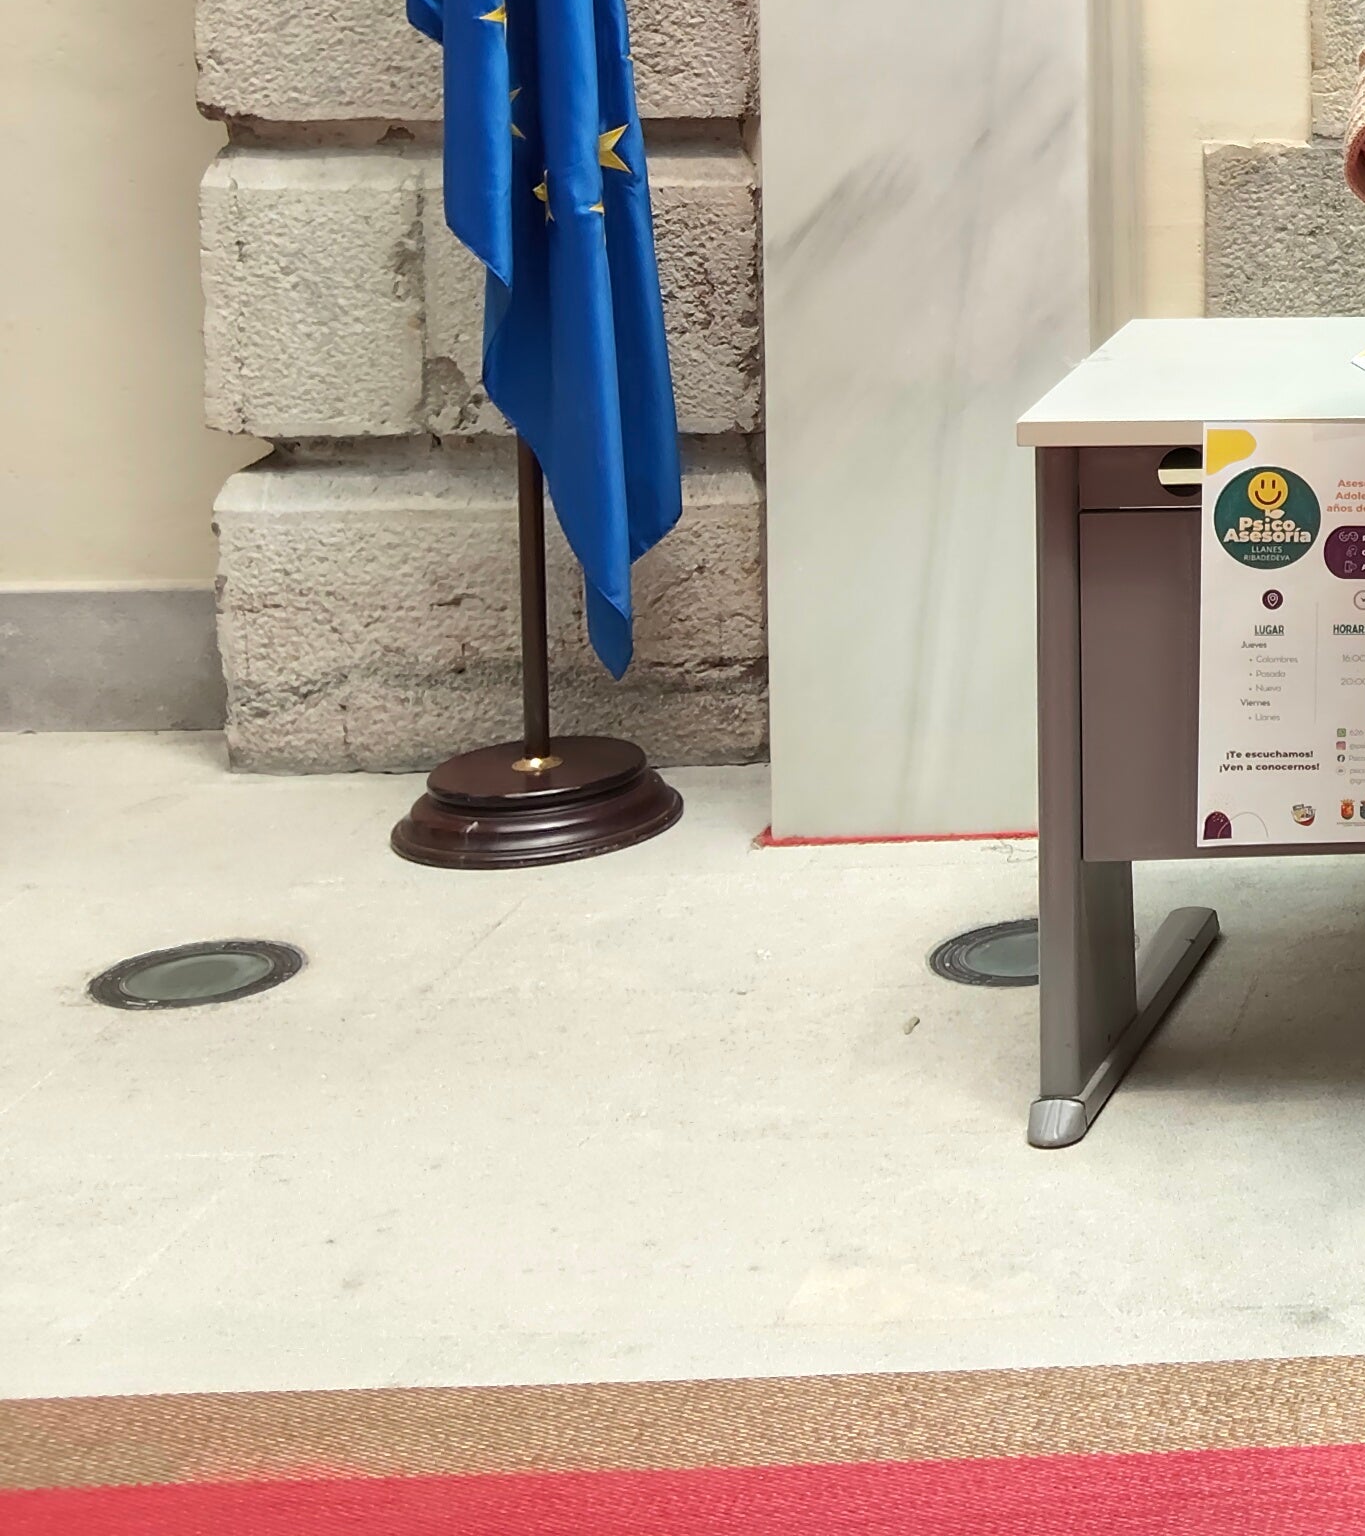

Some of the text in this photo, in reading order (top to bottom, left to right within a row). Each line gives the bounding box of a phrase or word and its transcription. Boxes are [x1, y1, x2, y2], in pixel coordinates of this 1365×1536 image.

[1326, 504, 1352, 512] años
[1238, 516, 1296, 531] Psico
[1222, 526, 1311, 543] Asesoría
[1251, 545, 1283, 553] LLANES
[1243, 553, 1290, 561] RIBADEDEVA
[1254, 625, 1284, 634] LUGAR
[1240, 640, 1267, 648] Jueves
[1240, 698, 1270, 706] Viernes
[1225, 750, 1313, 759] ¡Te escuchamos!
[1218, 762, 1319, 772] ¡Ven conocernos!
